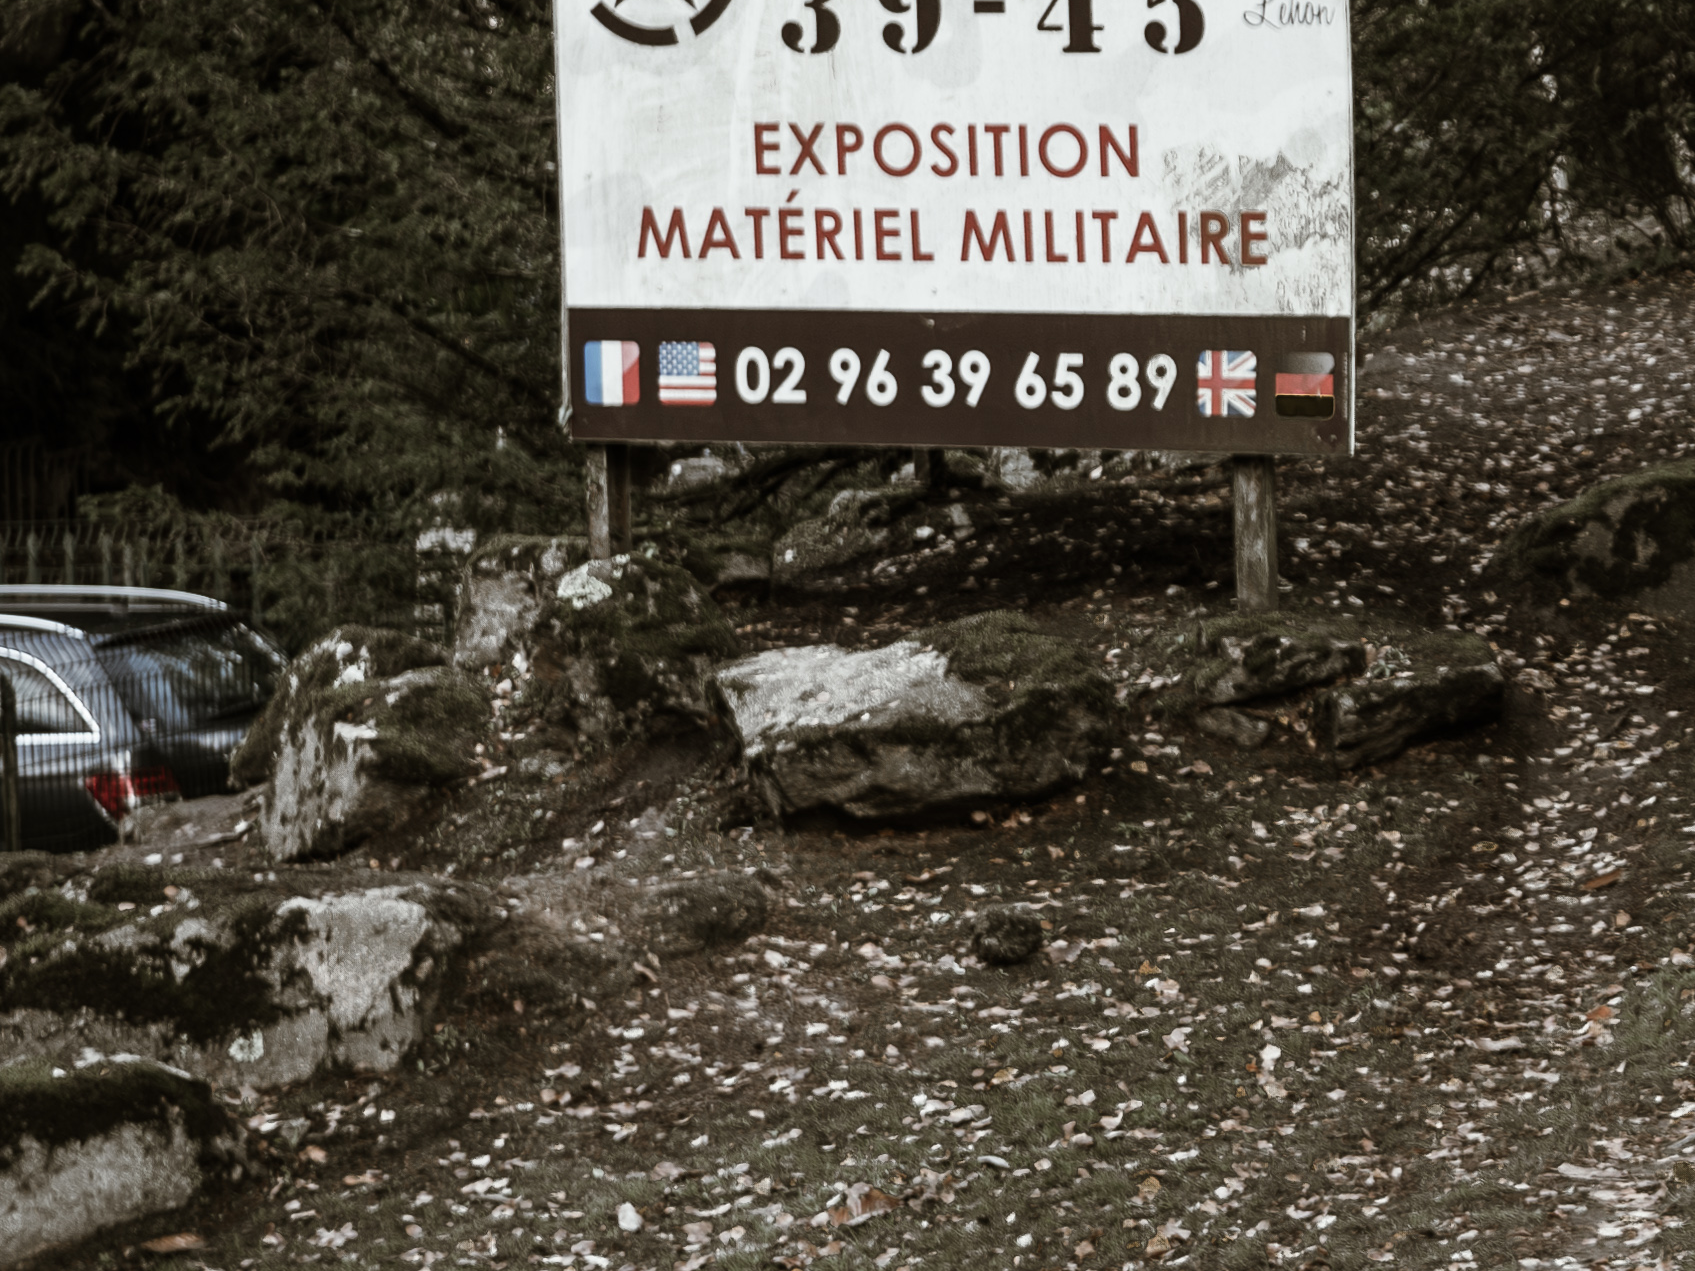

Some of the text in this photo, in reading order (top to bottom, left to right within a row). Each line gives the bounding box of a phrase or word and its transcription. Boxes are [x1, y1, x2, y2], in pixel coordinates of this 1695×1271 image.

[754, 122, 1140, 179] EXPOSITION
[637, 190, 1269, 266] MATÉRIEL MILITAIRE
[735, 346, 1178, 412] 02 96 39 65 89
